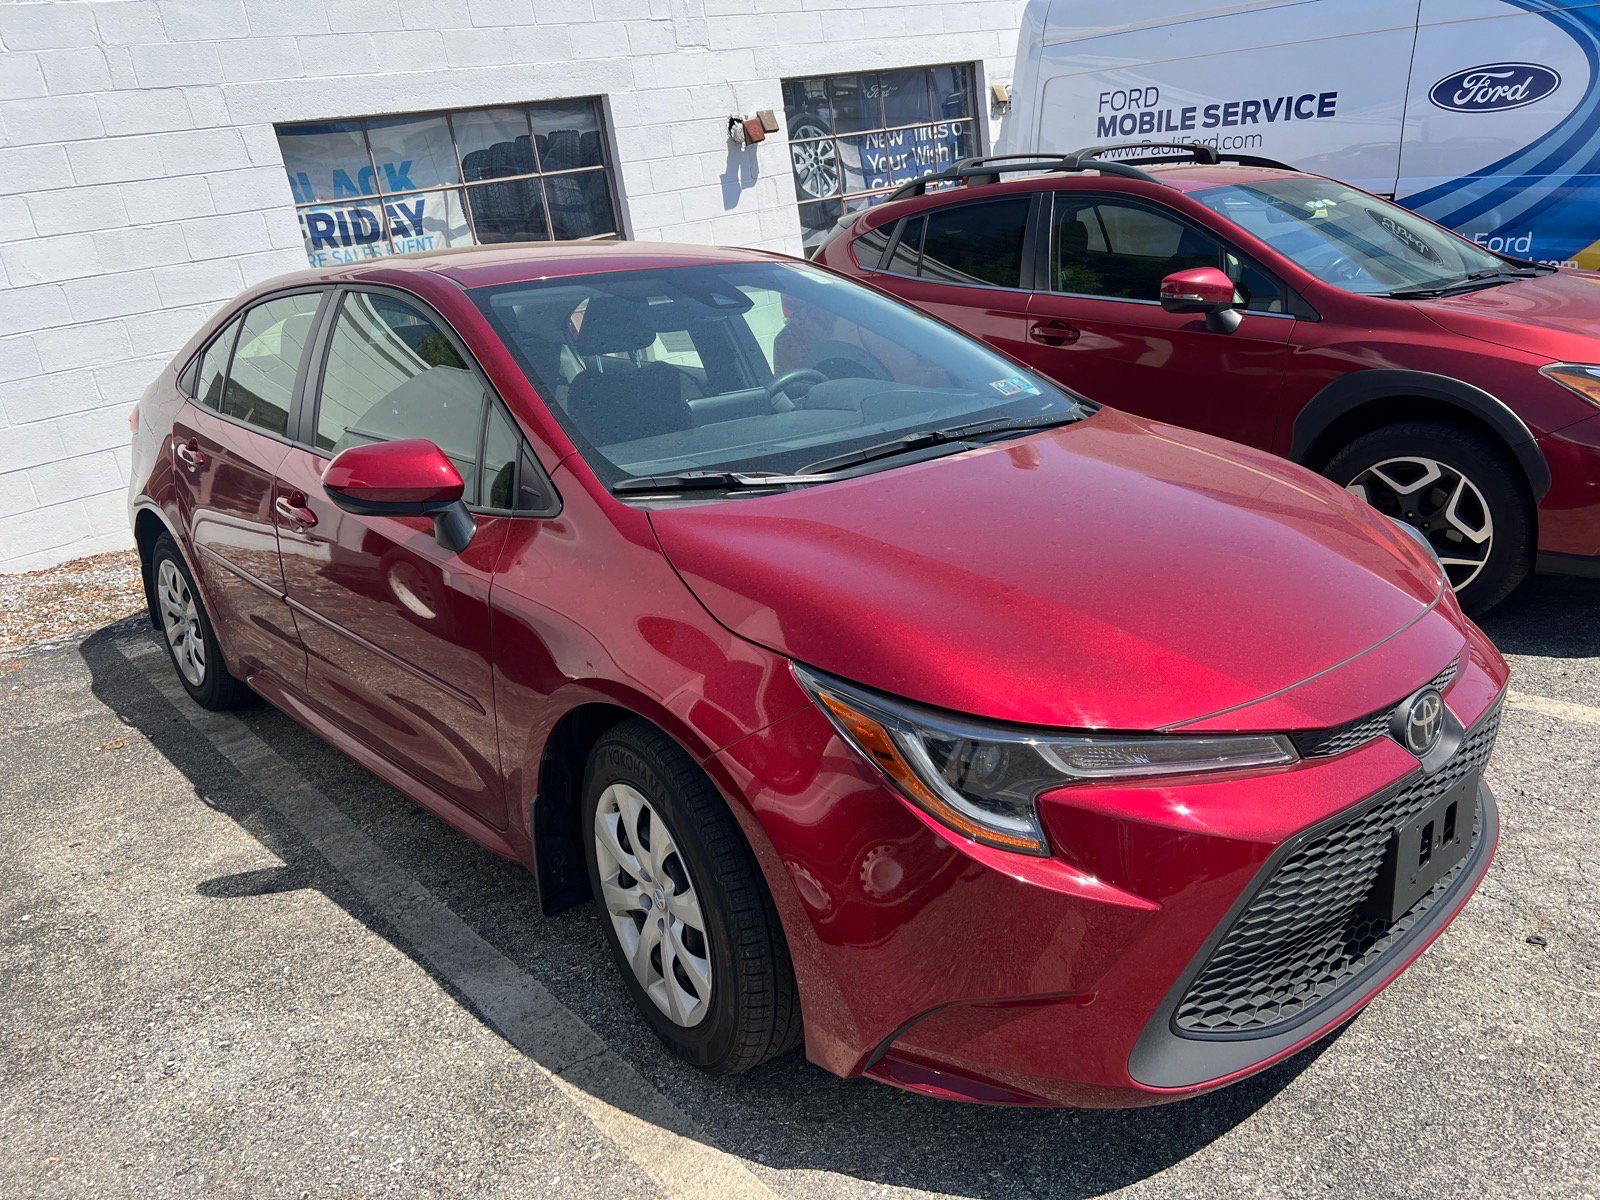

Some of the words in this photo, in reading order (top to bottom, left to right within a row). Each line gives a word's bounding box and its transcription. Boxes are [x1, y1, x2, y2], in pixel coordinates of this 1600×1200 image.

[1098, 86, 1160, 113] FORD
[1453, 70, 1534, 105] Ford
[1097, 106, 1197, 138] MOBILE
[1201, 91, 1338, 129] SERVICE
[866, 130, 904, 149] New
[908, 122, 949, 143] Tires
[866, 152, 908, 174] Your
[911, 143, 949, 167] Wish
[1474, 232, 1532, 253] Ford
